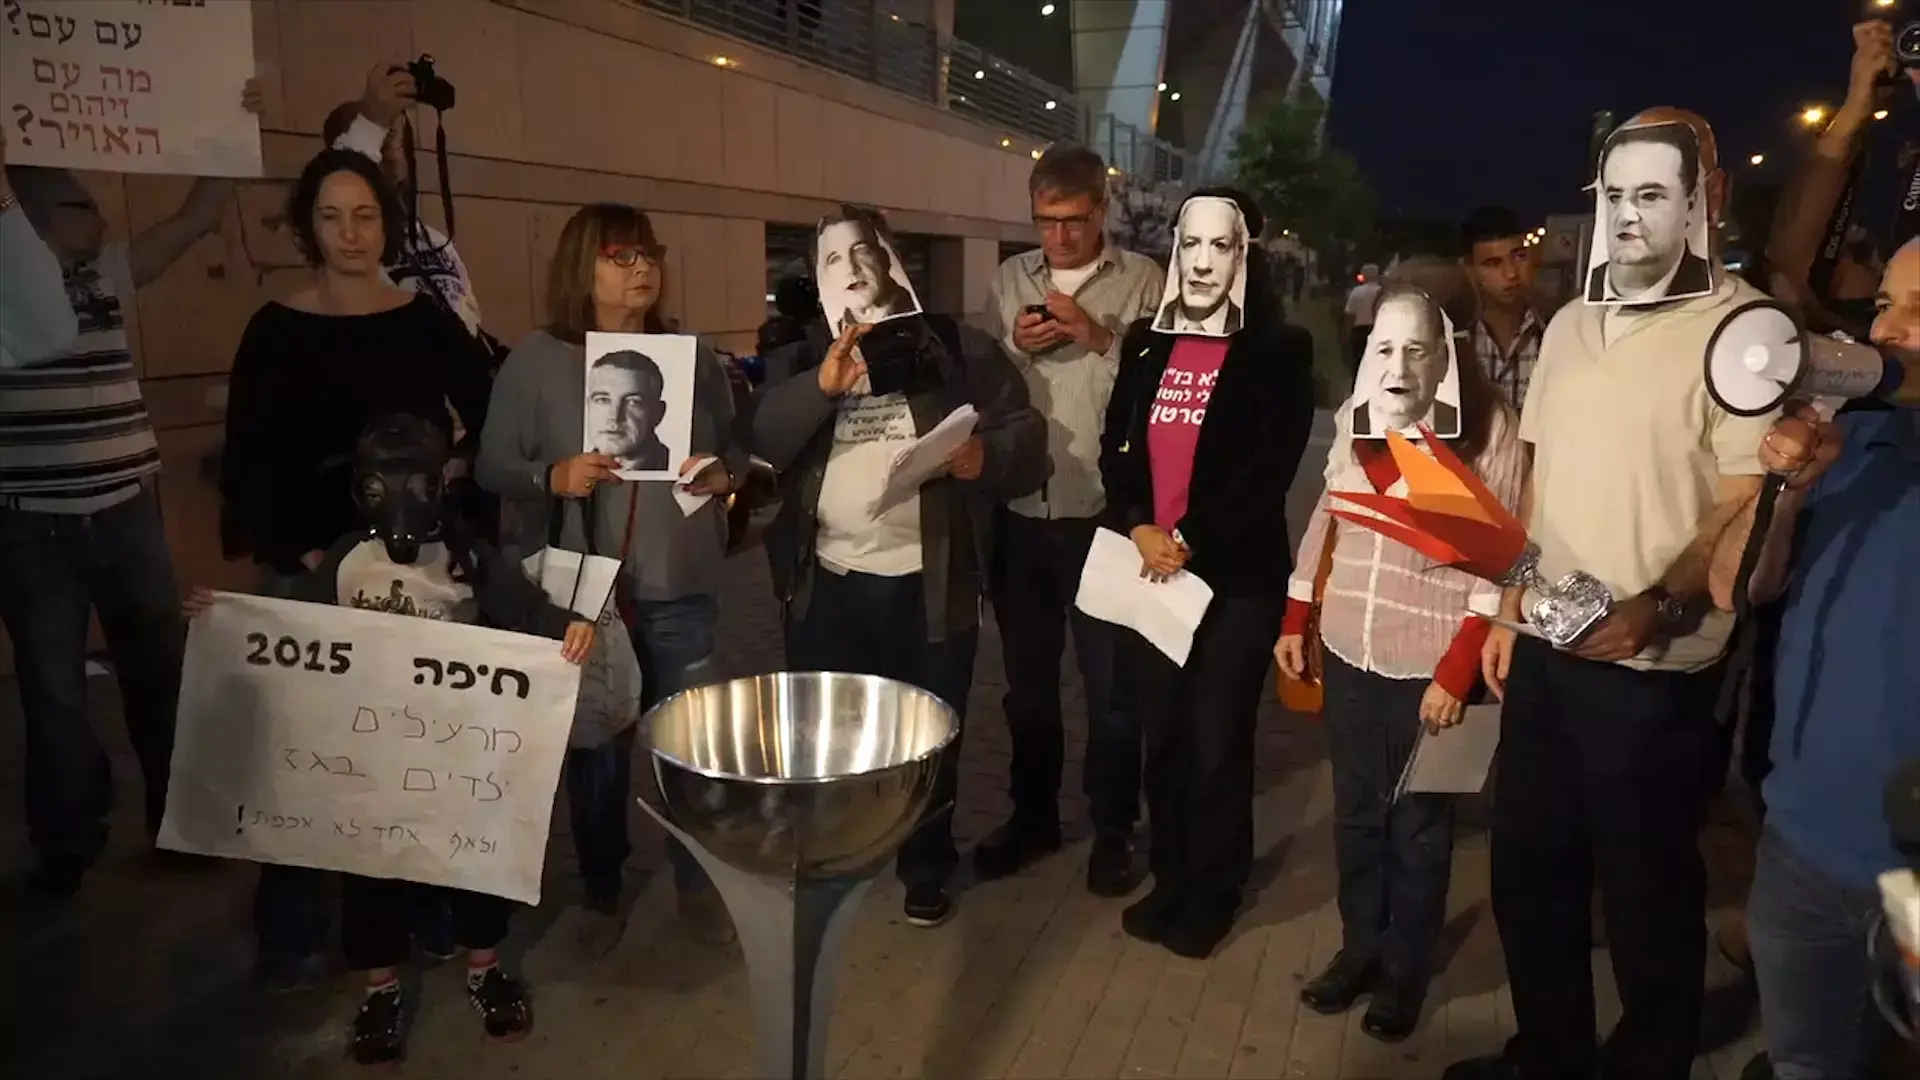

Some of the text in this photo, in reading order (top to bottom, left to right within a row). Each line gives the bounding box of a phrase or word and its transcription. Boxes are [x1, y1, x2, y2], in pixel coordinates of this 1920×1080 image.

[4, 0, 142, 50] עם עם?
[32, 57, 152, 93] מה עם
[50, 91, 130, 119] זיהום
[12, 103, 160, 155] האויר?
[1903, 167, 1920, 211] Can
[1156, 387, 1193, 402] לחטו
[245, 631, 354, 676] 2015
[413, 655, 531, 700] חיפה
[351, 704, 523, 754] מרעילים
[284, 748, 510, 802] ילדים בגז
[332, 818, 362, 838] לא
[373, 824, 421, 845] אחד
[449, 833, 498, 860] ולאף
